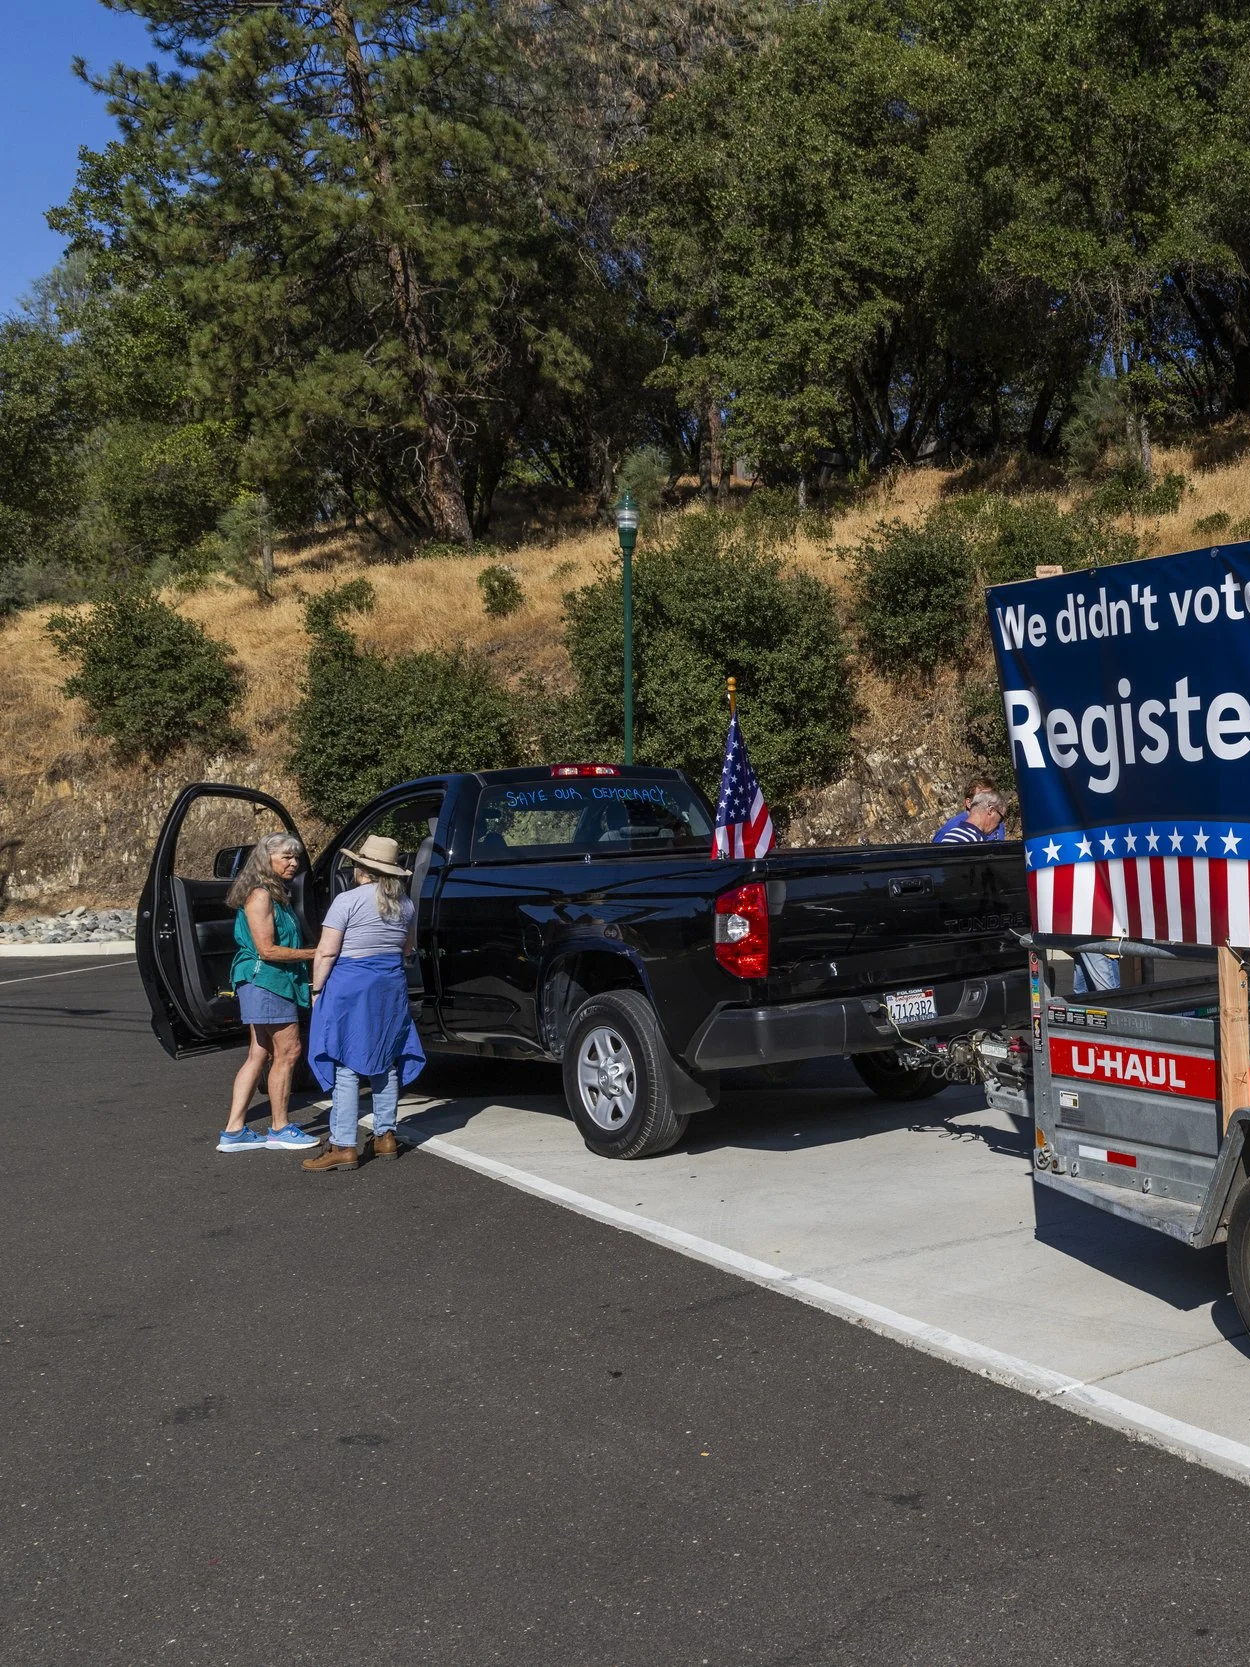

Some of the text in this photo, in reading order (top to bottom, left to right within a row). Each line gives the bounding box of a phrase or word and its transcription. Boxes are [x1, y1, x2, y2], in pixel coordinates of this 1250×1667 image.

[996, 603, 1047, 650] We
[1056, 584, 1159, 644] didn't
[506, 785, 666, 807] SAVE OUR DEMOCRACY
[943, 911, 1026, 934] TUNDRA
